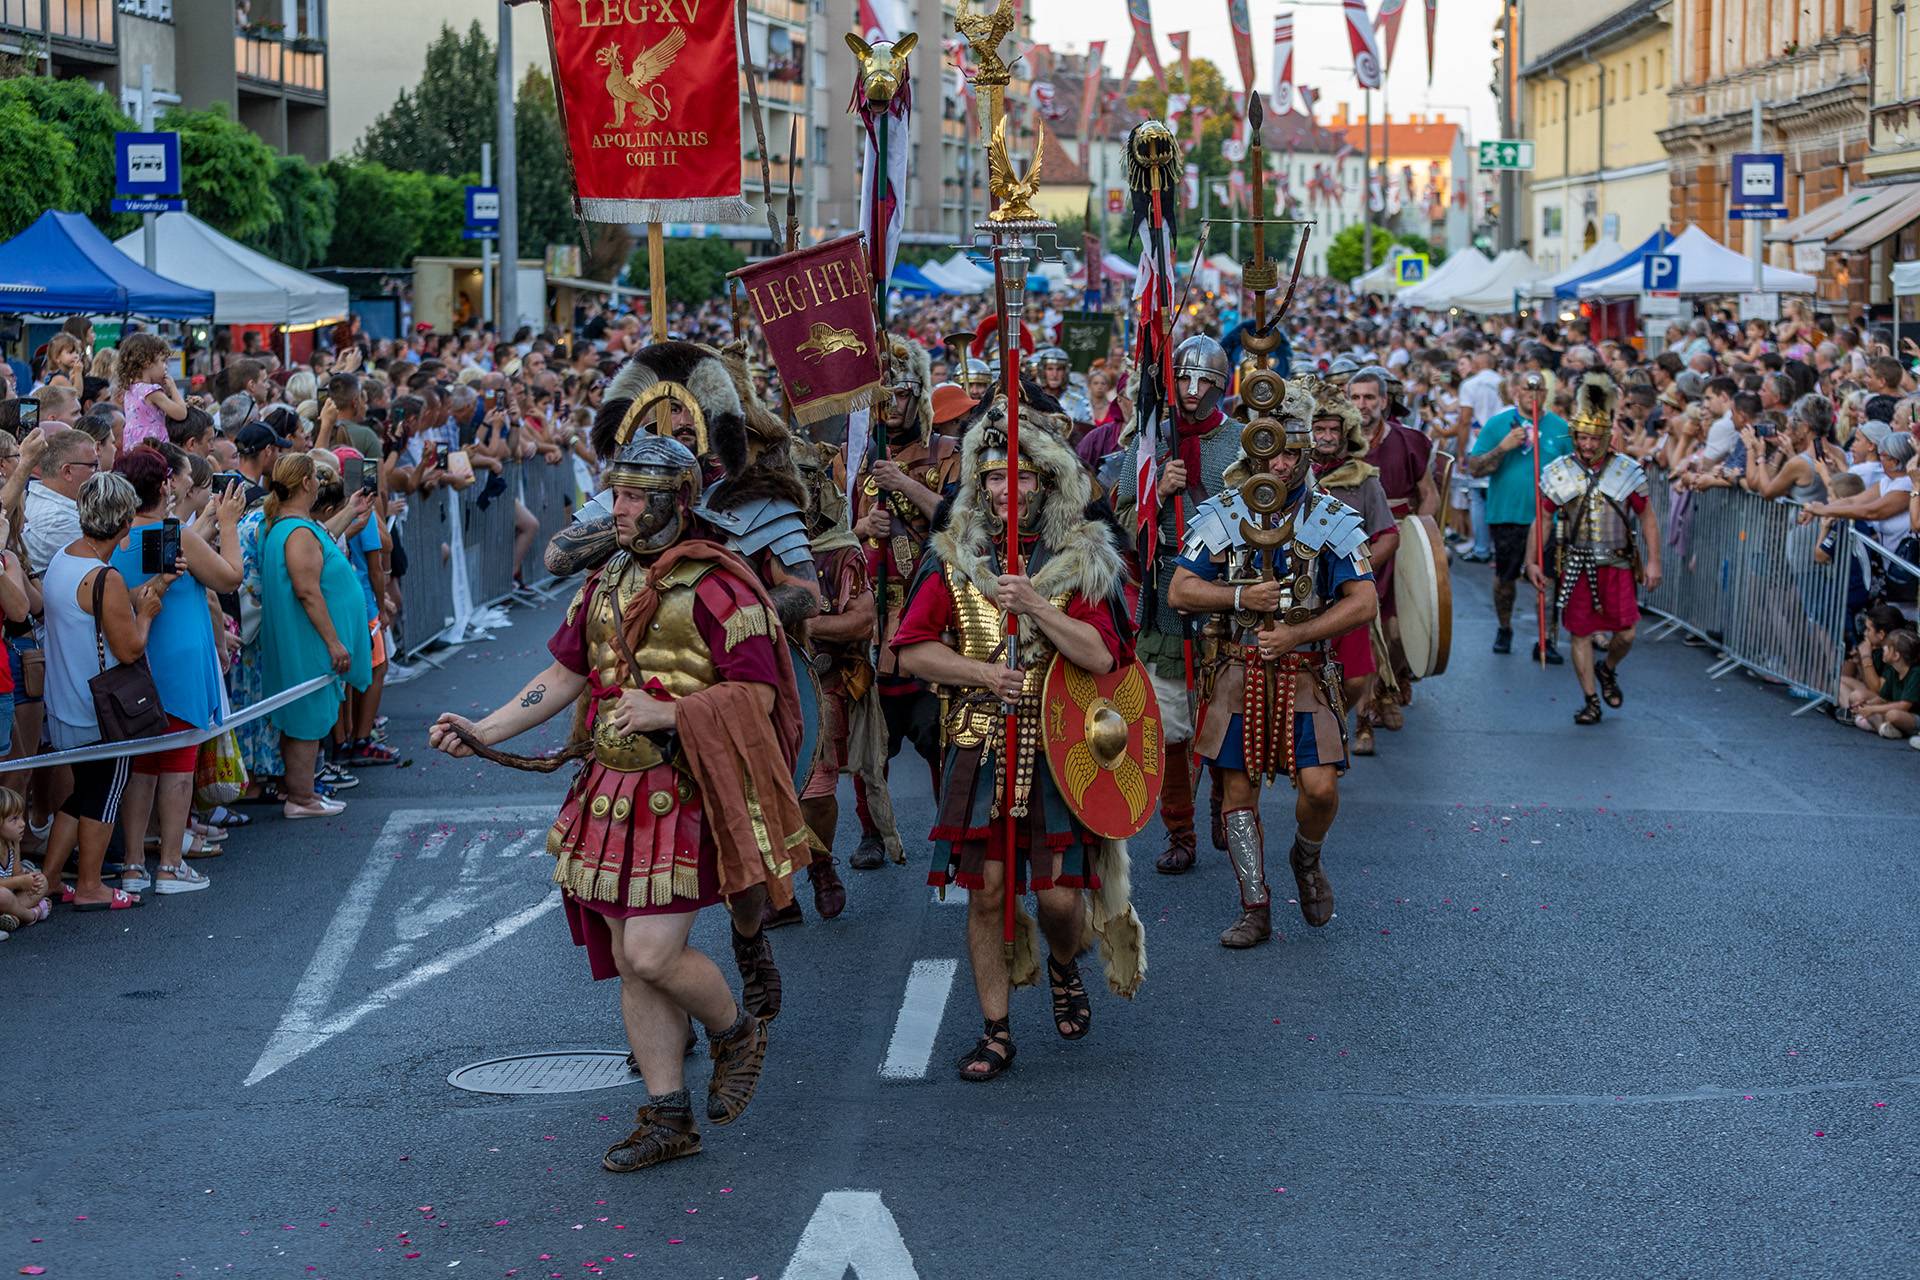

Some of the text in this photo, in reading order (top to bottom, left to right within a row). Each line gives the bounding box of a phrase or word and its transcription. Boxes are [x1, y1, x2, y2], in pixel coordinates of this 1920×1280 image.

[592, 131, 708, 148] APOLLINARIS
[626, 150, 680, 166] COH II
[1651, 257, 1673, 288] P
